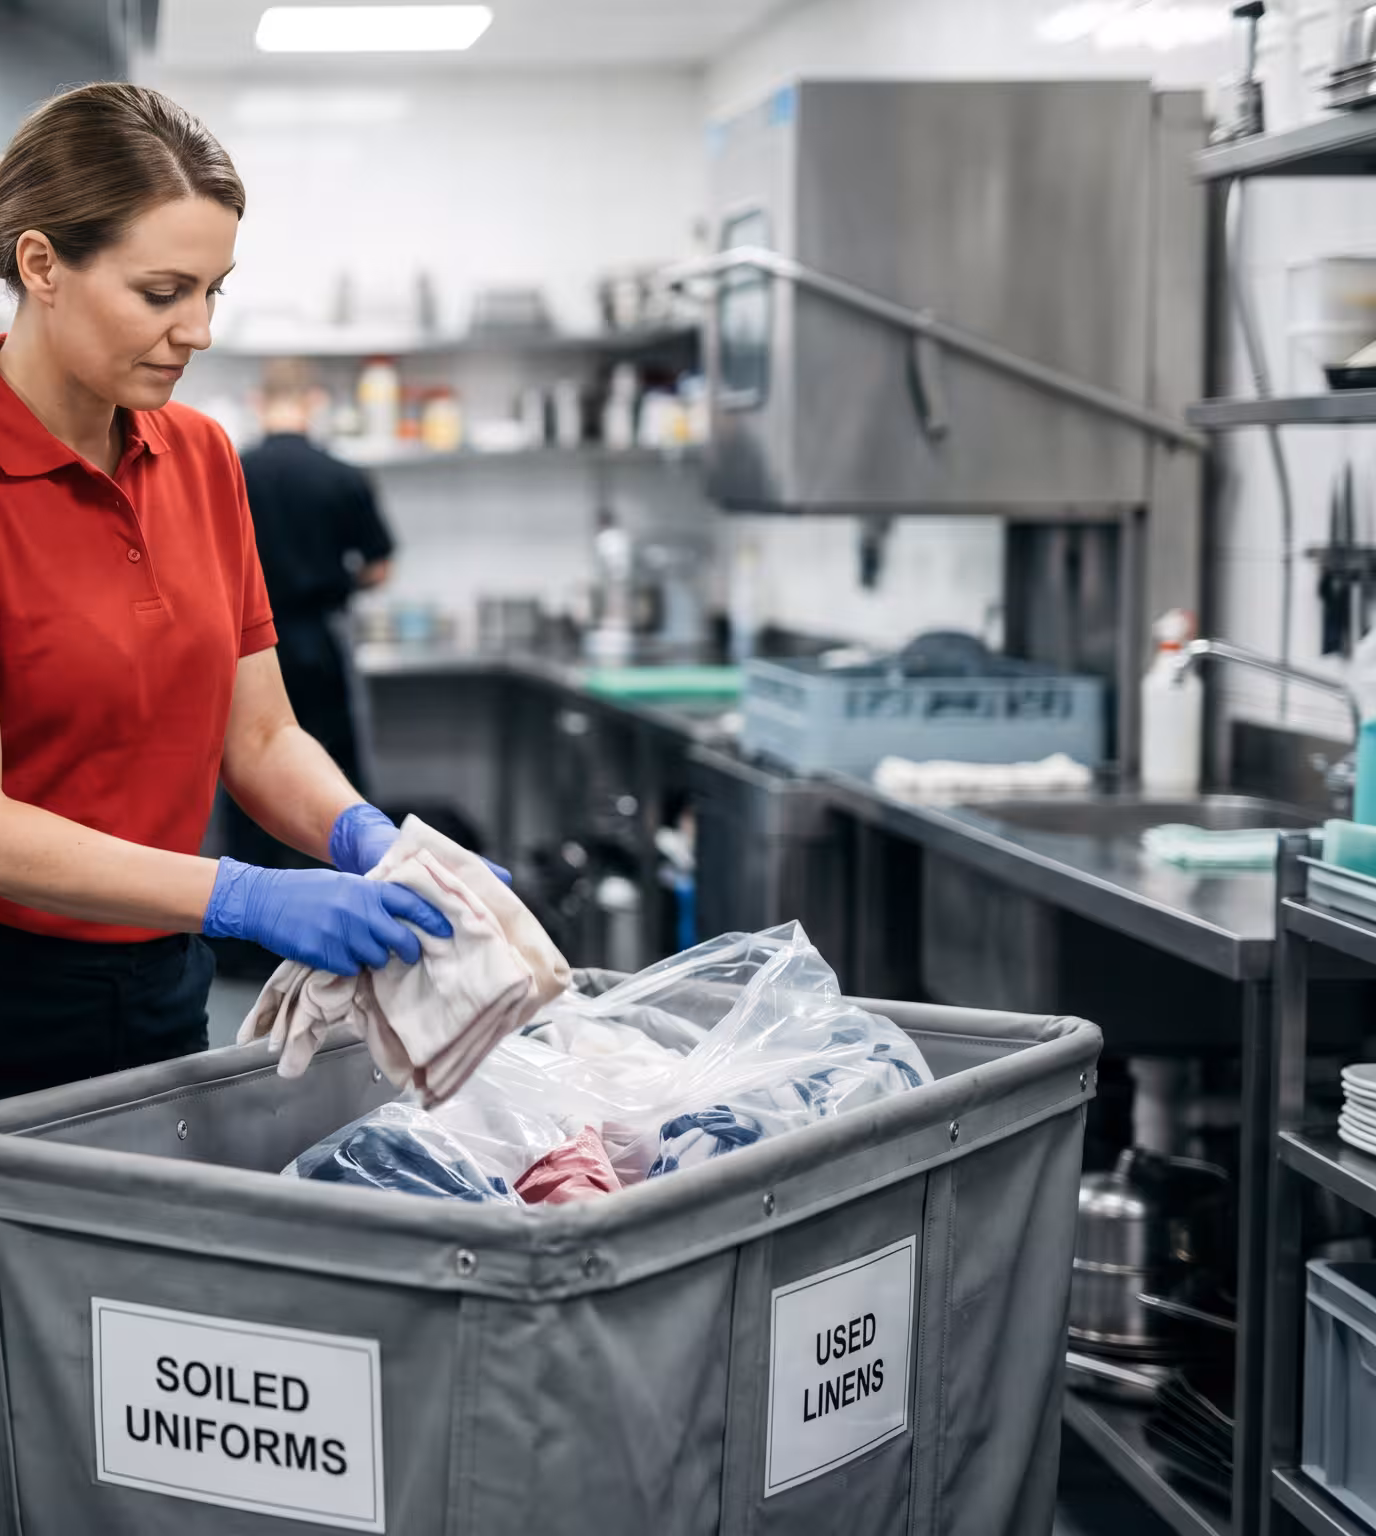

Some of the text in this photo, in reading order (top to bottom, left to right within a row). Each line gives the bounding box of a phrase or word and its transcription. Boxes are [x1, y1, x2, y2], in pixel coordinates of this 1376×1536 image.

[816, 1312, 876, 1366] USED
[155, 1356, 309, 1412] SOILED
[803, 1358, 884, 1423] LINENS
[126, 1404, 348, 1475] UNIFORMS
